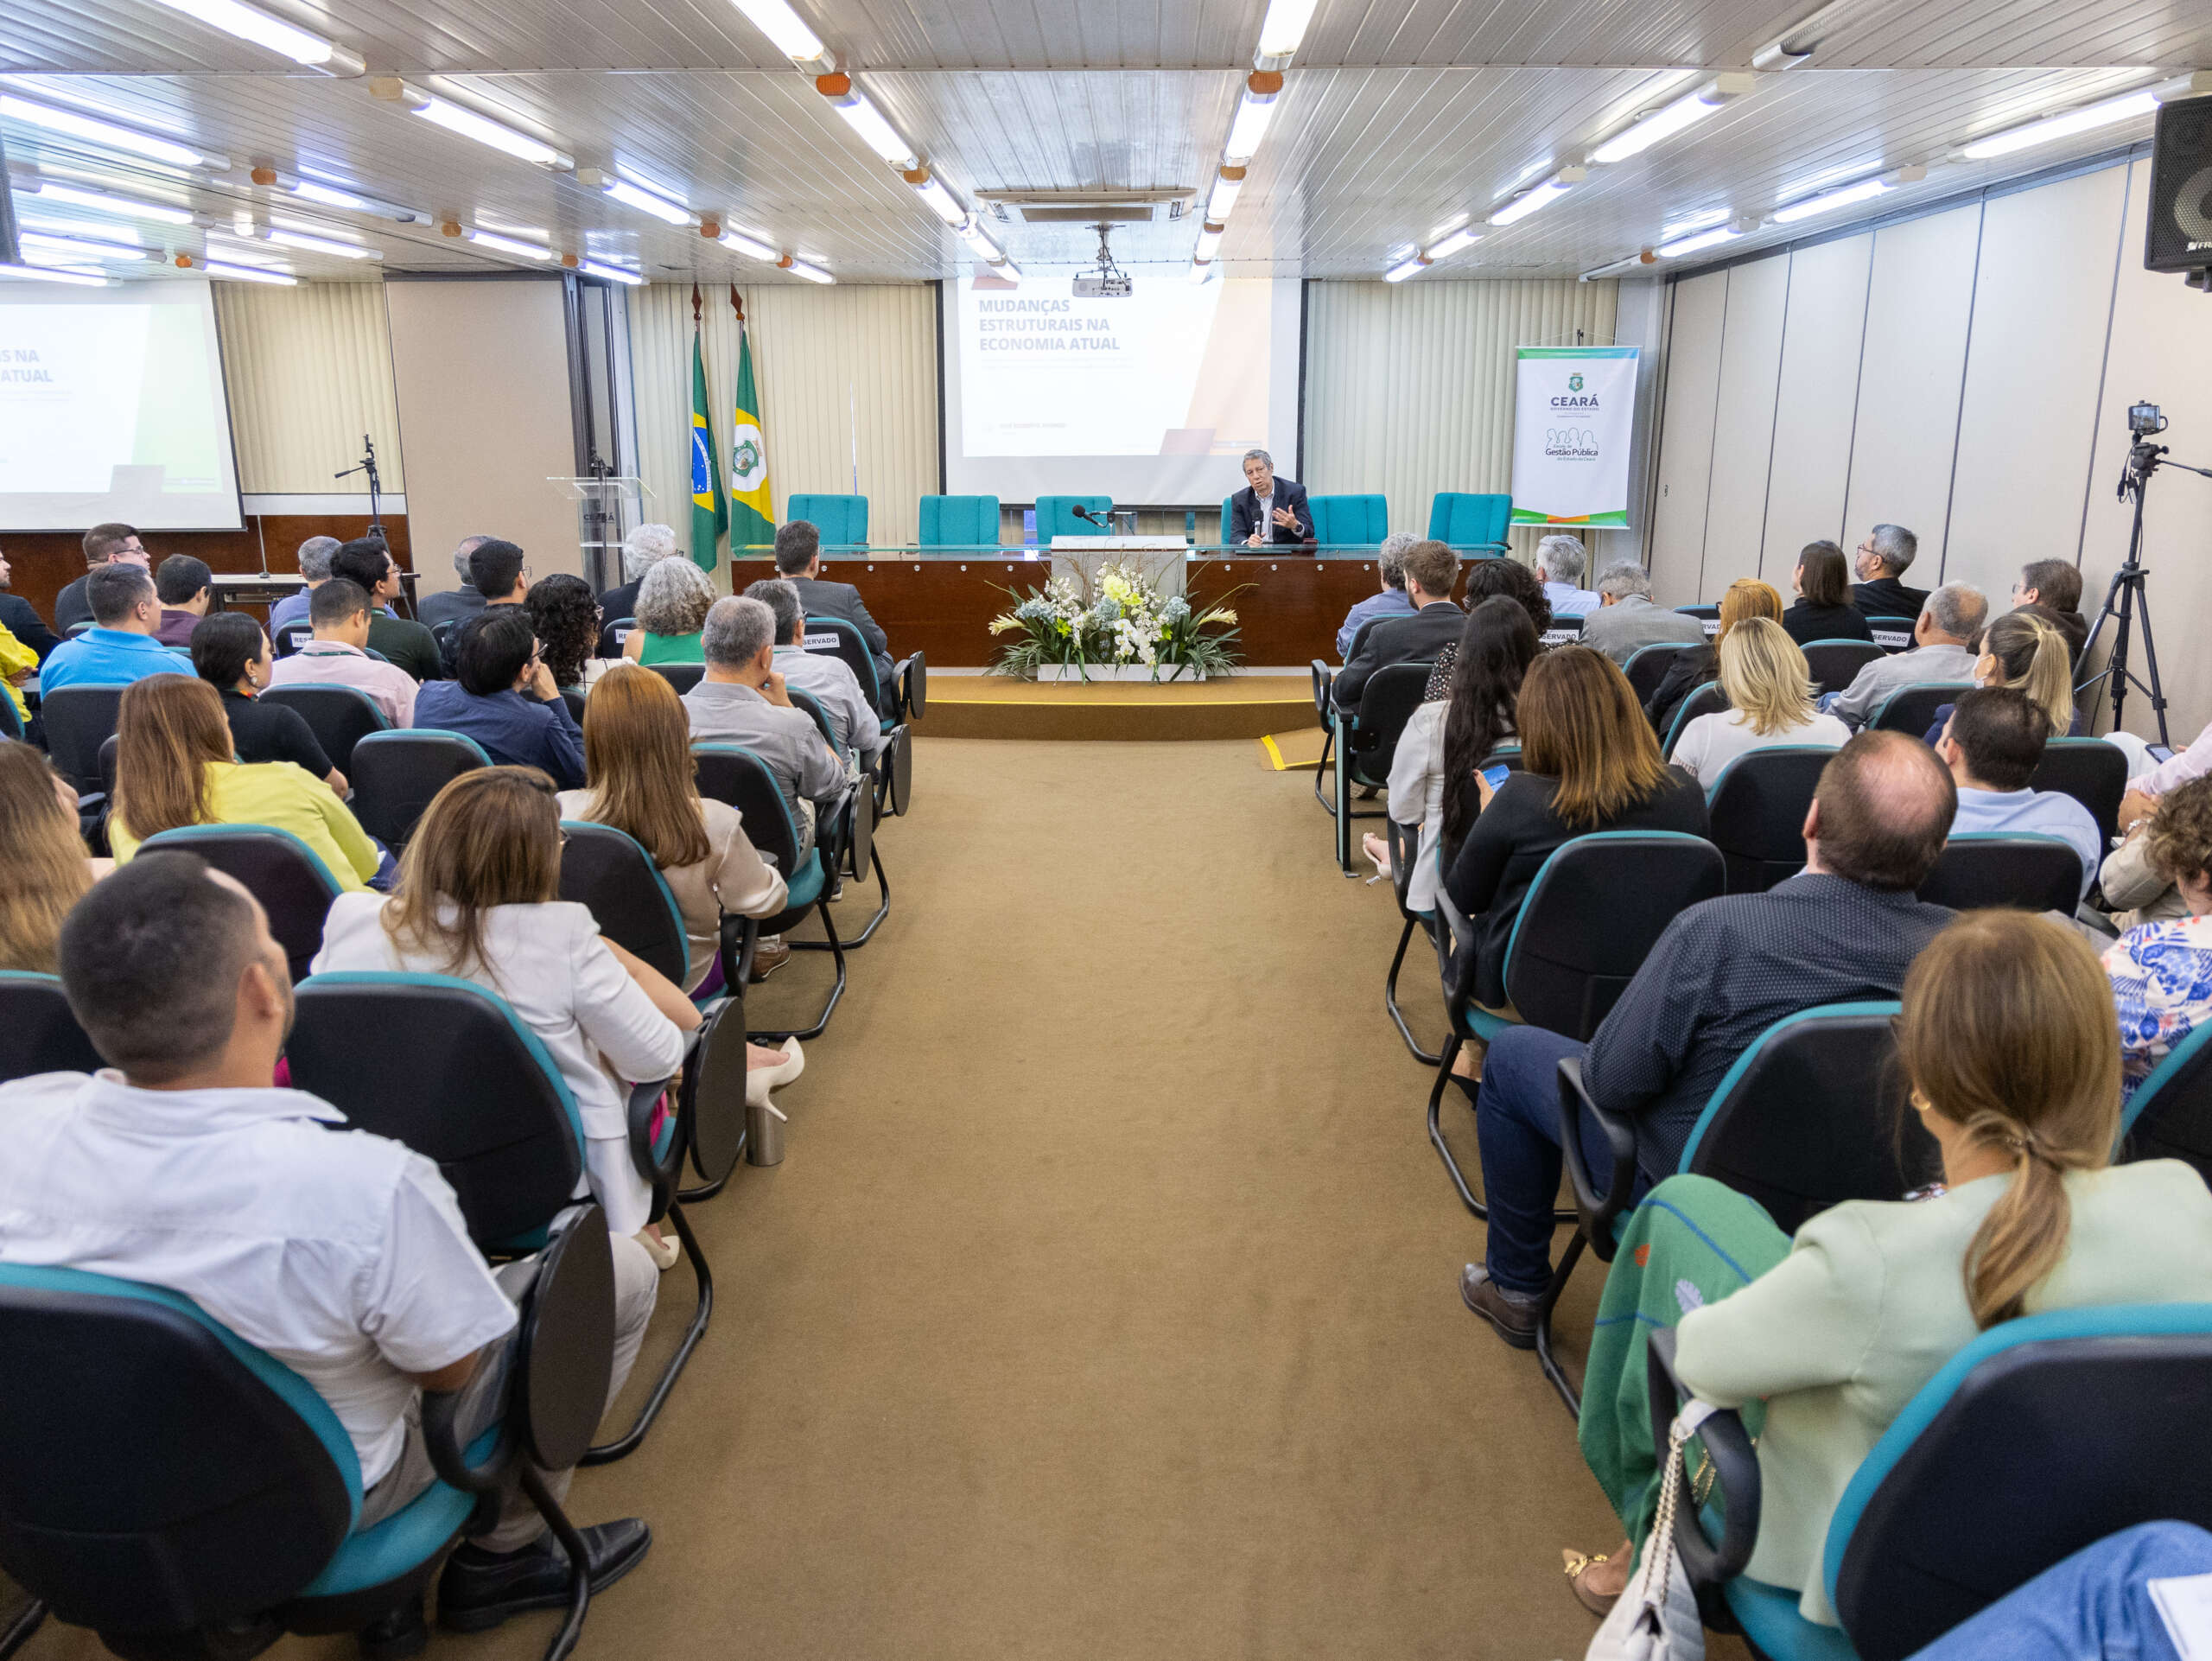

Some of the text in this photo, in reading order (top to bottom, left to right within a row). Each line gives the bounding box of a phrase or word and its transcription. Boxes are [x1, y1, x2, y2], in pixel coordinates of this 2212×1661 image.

[979, 299, 1071, 315] MUDANÇAS
[979, 318, 1110, 331] ESTRUTURAIS NA
[980, 337, 1121, 351] ECONOMIA ATUAL
[15, 349, 40, 363] NA
[1, 369, 54, 383] ATUAL
[1550, 394, 1599, 406] CEARÁ
[1572, 448, 1599, 456] Pública
